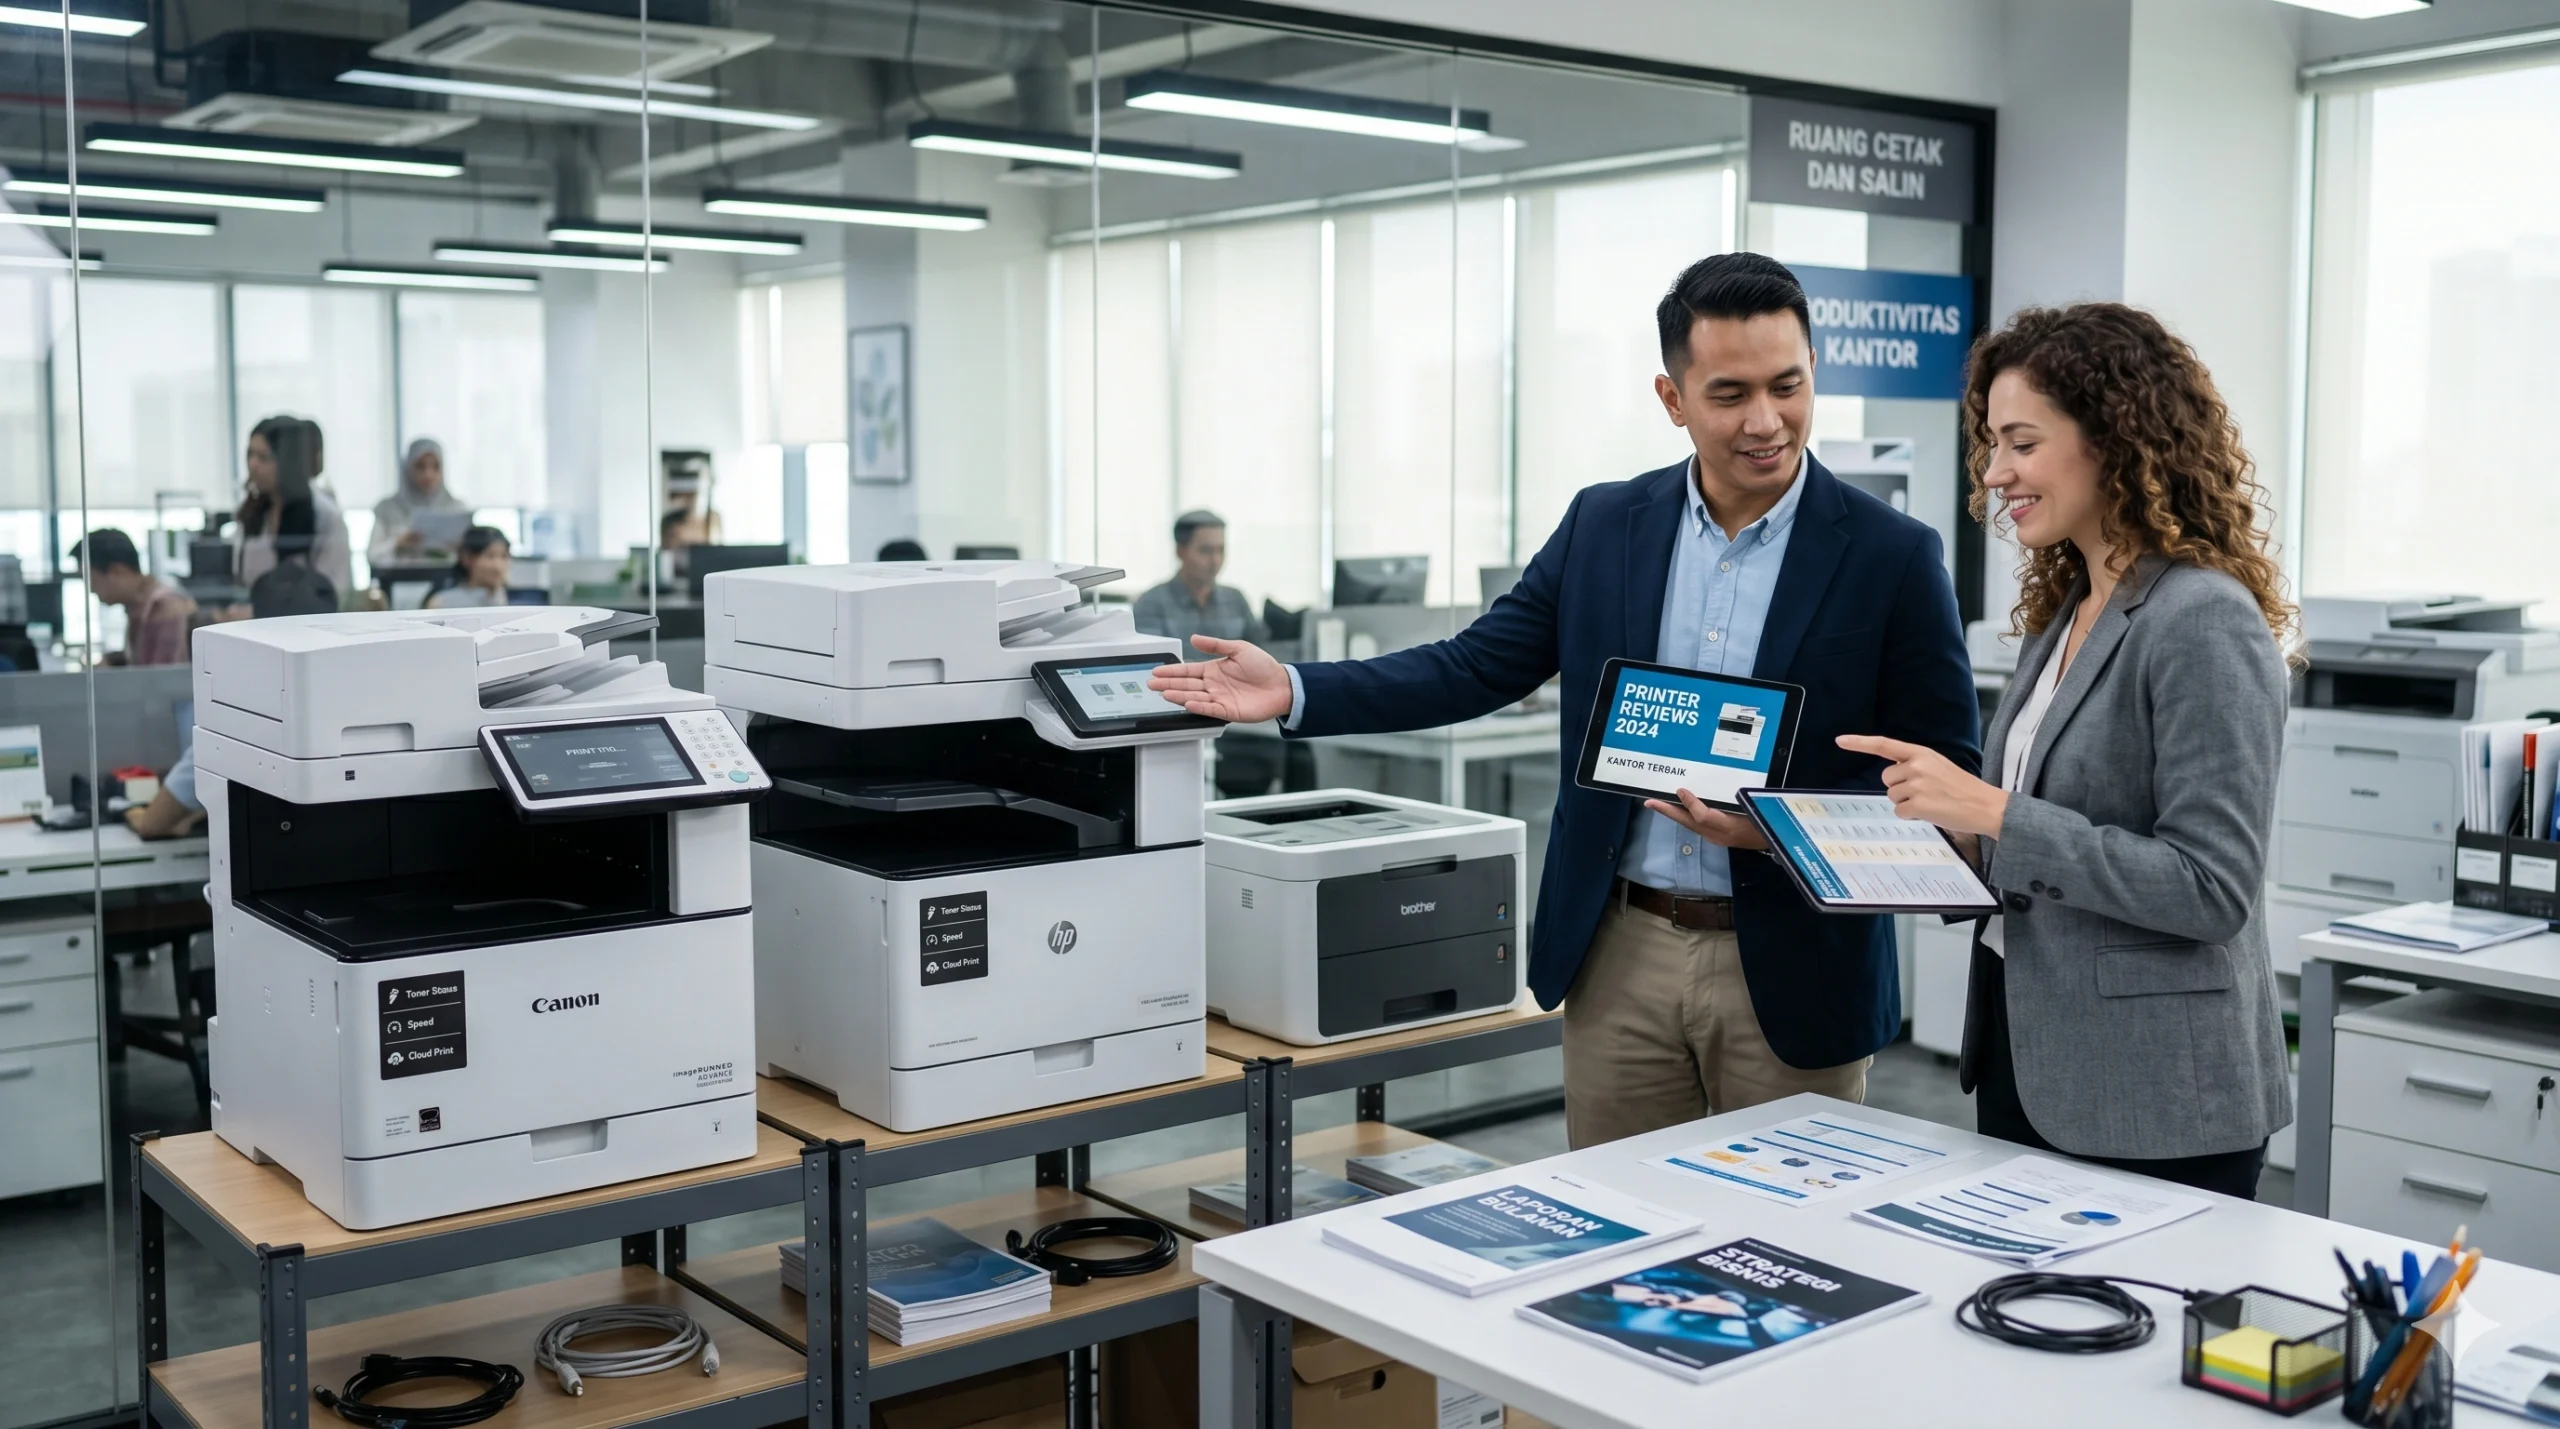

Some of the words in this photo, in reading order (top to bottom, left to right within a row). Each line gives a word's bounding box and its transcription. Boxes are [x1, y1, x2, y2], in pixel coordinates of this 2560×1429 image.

[1789, 120, 1868, 158] RUANG
[1873, 131, 1943, 166] CETAK
[1807, 160, 1855, 192] DAN
[1859, 166, 1925, 200] SALIN
[1807, 297, 1960, 335] ODUKTIVITAS
[1824, 335, 1918, 369] KANTOR
[1623, 683, 1700, 709] PRINTER
[1619, 700, 1699, 726] REVIEWS
[1615, 718, 1659, 738] 2024
[565, 747, 595, 756] PRINT
[1606, 756, 1645, 770] KANTOR
[1647, 762, 1686, 777] TERBAIK
[1400, 901, 1436, 916] brother
[941, 931, 963, 943] Speed
[1050, 921, 1075, 954] hp
[963, 957, 980, 966] Print
[405, 988, 430, 999] Toner
[531, 992, 600, 1014] Canon
[407, 1016, 434, 1030] Speed
[408, 1048, 433, 1061] Cloud
[433, 1046, 454, 1057] Print
[1477, 1196, 1585, 1240] BULANAN
[1496, 1189, 1604, 1232] LAPORAN
[1696, 1253, 1786, 1289] BISNIS
[1717, 1247, 1842, 1292] STRATEGI
